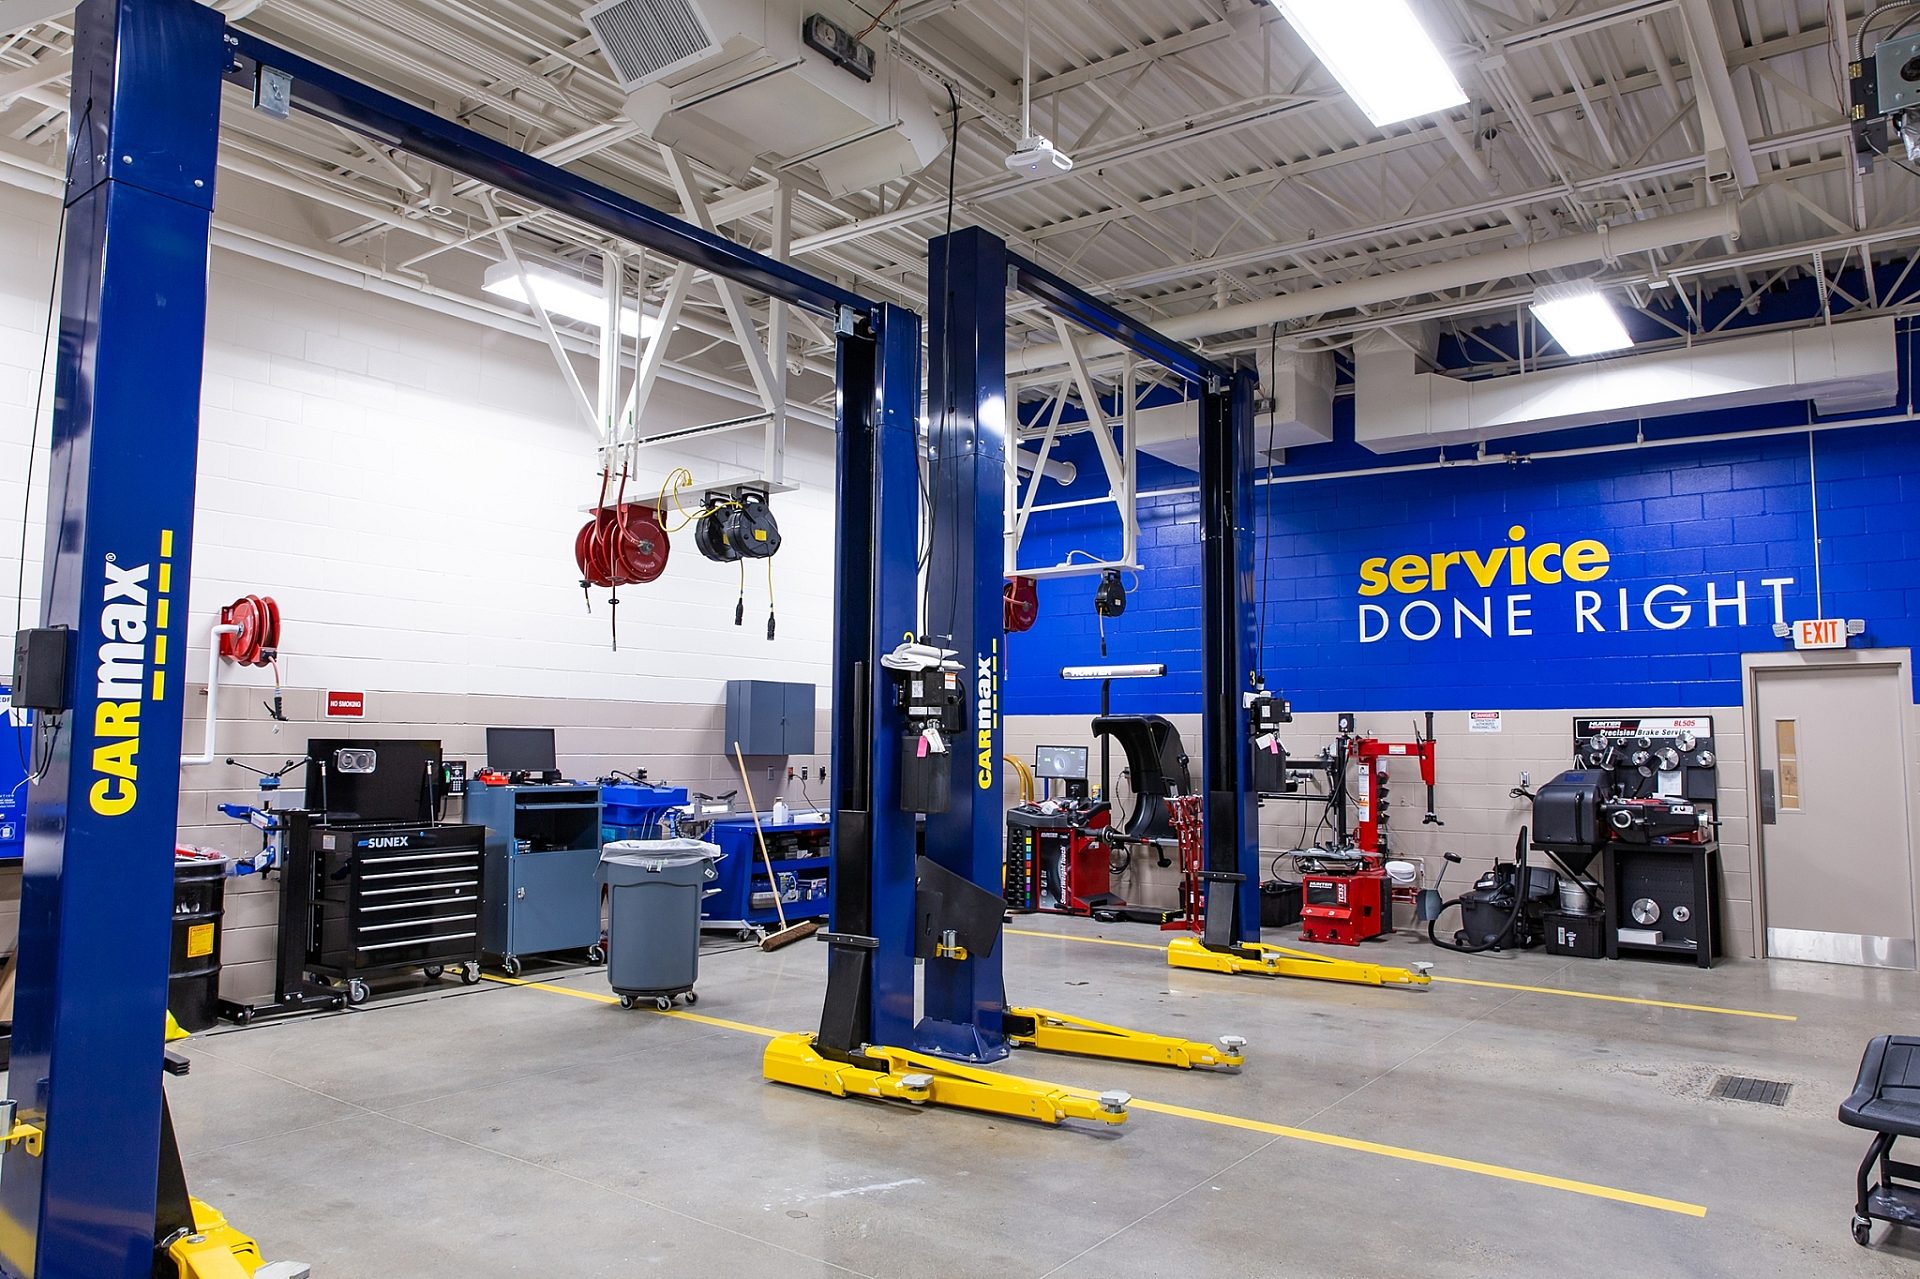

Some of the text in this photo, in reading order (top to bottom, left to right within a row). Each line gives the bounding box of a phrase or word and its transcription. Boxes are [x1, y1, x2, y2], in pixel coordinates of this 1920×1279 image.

[1357, 524, 1611, 597] service
[1358, 577, 1794, 643] DONE RIGHT
[1802, 621, 1838, 644] EXIT
[1600, 729, 1636, 737] Precision
[1637, 728, 1660, 736] Brake
[368, 836, 408, 848] SUNEX
